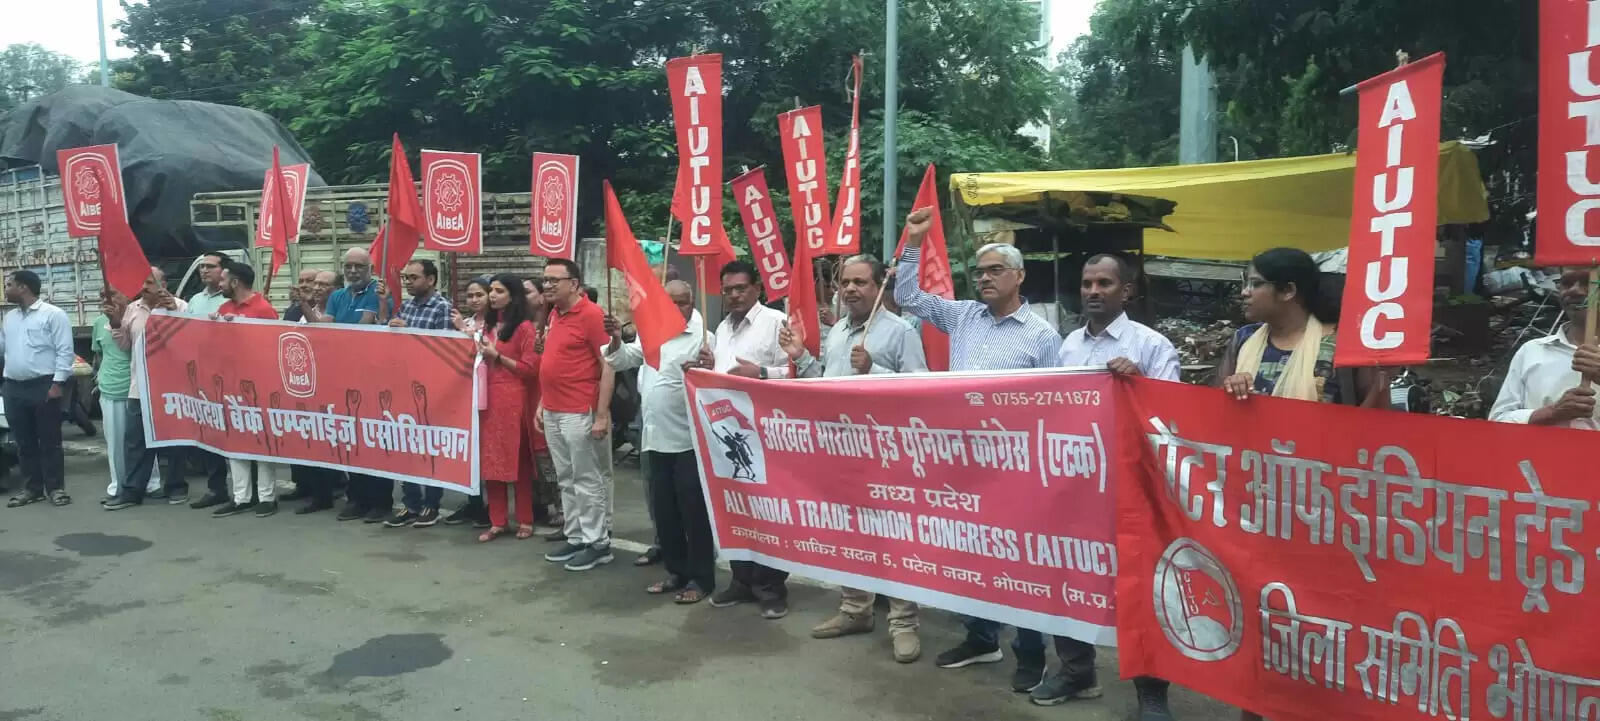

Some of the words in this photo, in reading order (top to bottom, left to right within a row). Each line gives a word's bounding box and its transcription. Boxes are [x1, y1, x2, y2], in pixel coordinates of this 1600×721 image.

[683, 66, 711, 246] AIUTUC
[792, 115, 824, 249] AIUTUC
[80, 200, 102, 217] AIBE
[436, 212, 464, 231] AIBEA
[541, 215, 562, 237] AIBEA
[1360, 80, 1416, 349] AIUTUC
[744, 184, 790, 290] AIUTUC
[289, 372, 310, 387] AIBEA
[992, 390, 1101, 406] 0755-2741873
[224, 395, 264, 434] बैंक
[760, 408, 815, 454] अखिल
[815, 413, 874, 459] भारतीय
[865, 414, 900, 469] ट्रेड
[897, 416, 968, 479] यूनियन
[965, 417, 1030, 472] कांग्रेस
[1037, 418, 1107, 493] (एटक)
[867, 483, 916, 504] मध्य
[923, 483, 981, 513] प्रदेश
[723, 489, 749, 516] ALL
[747, 495, 794, 525] INDIA
[796, 499, 854, 533] TRADE
[856, 506, 914, 543] UNION
[917, 514, 1020, 562] CONGRESS
[1513, 460, 1590, 613] ट्रेड
[839, 546, 877, 565] सदन
[902, 554, 937, 576] पटेल
[993, 571, 1051, 598] भोपाल
[1183, 572, 1199, 615] CITU
[1259, 582, 1353, 691] जिला
[1354, 611, 1477, 721] समिति
